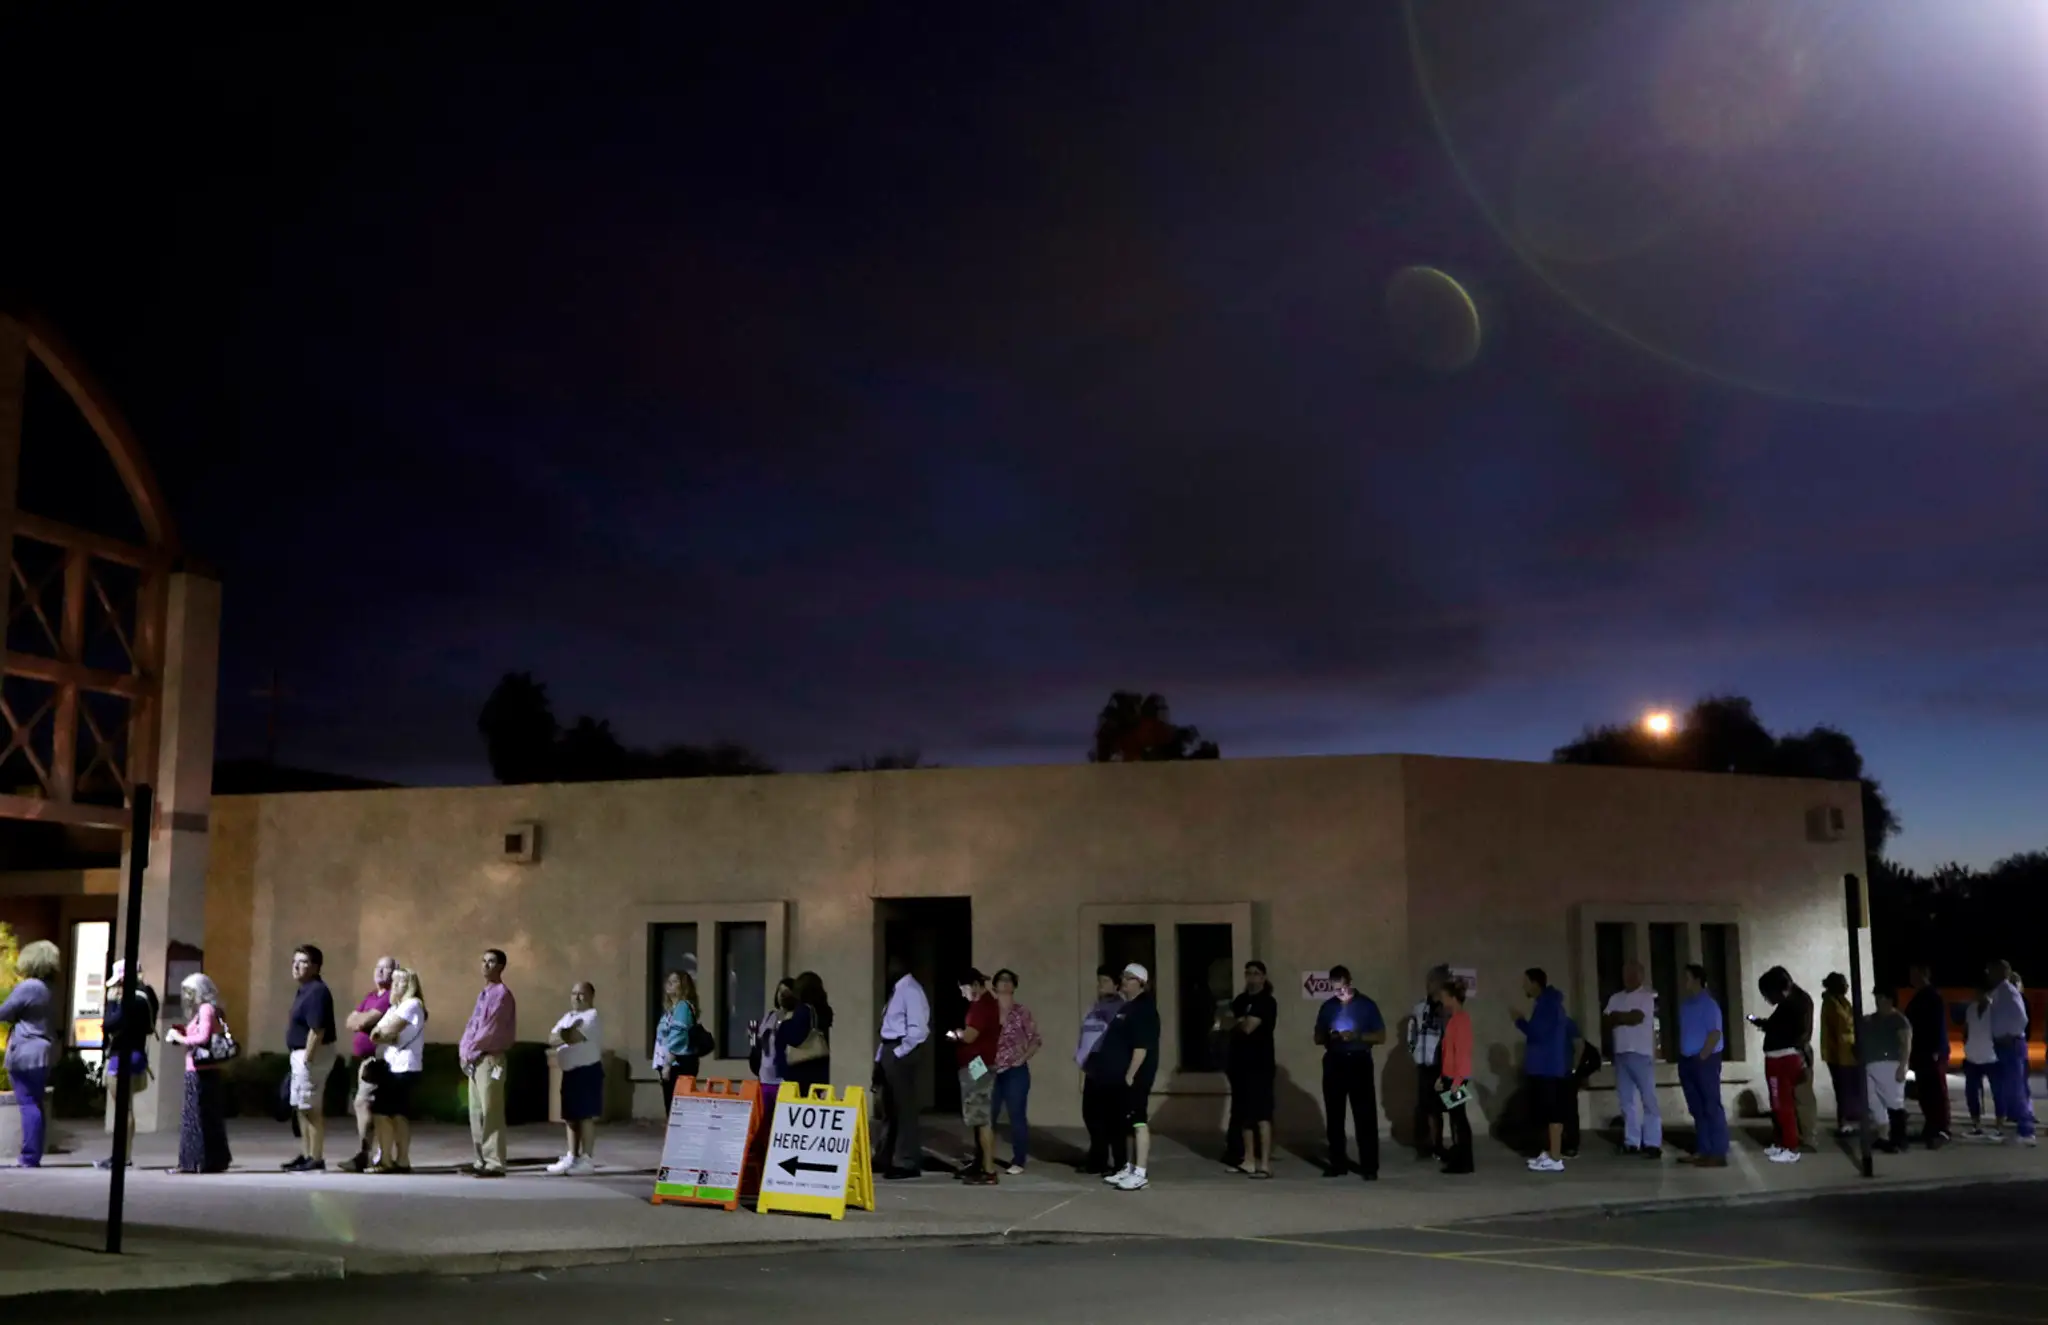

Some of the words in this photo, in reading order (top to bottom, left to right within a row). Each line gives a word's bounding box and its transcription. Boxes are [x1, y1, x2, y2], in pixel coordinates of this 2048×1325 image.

[1307, 978, 1333, 992] VOT
[788, 1106, 845, 1131] VOTE
[773, 1132, 851, 1154] HERE/AQUI
